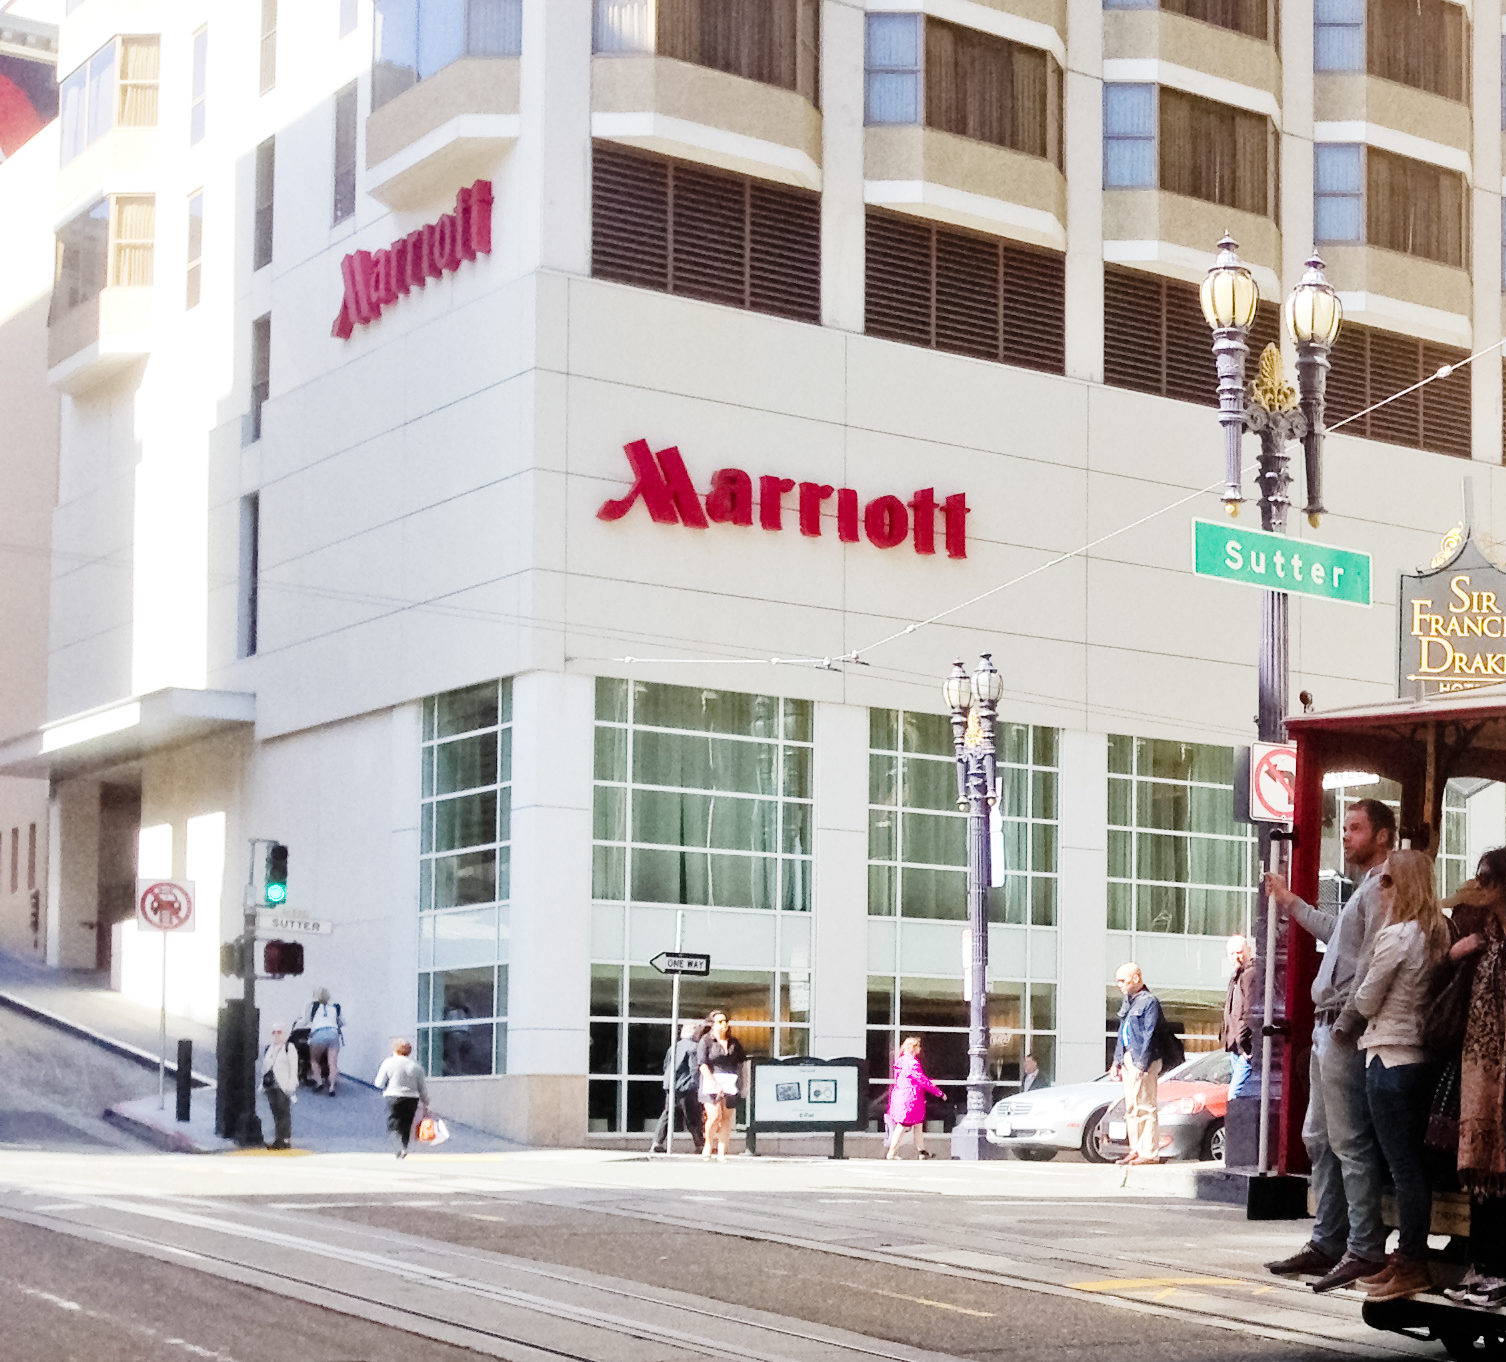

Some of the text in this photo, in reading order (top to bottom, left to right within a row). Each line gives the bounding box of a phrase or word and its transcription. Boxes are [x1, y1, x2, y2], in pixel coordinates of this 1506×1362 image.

[331, 179, 494, 341] Marriott
[597, 438, 971, 560] Marriott
[1225, 540, 1345, 588] Sutter
[272, 919, 320, 932] SUTTER
[667, 959, 704, 969] ONE WAY
